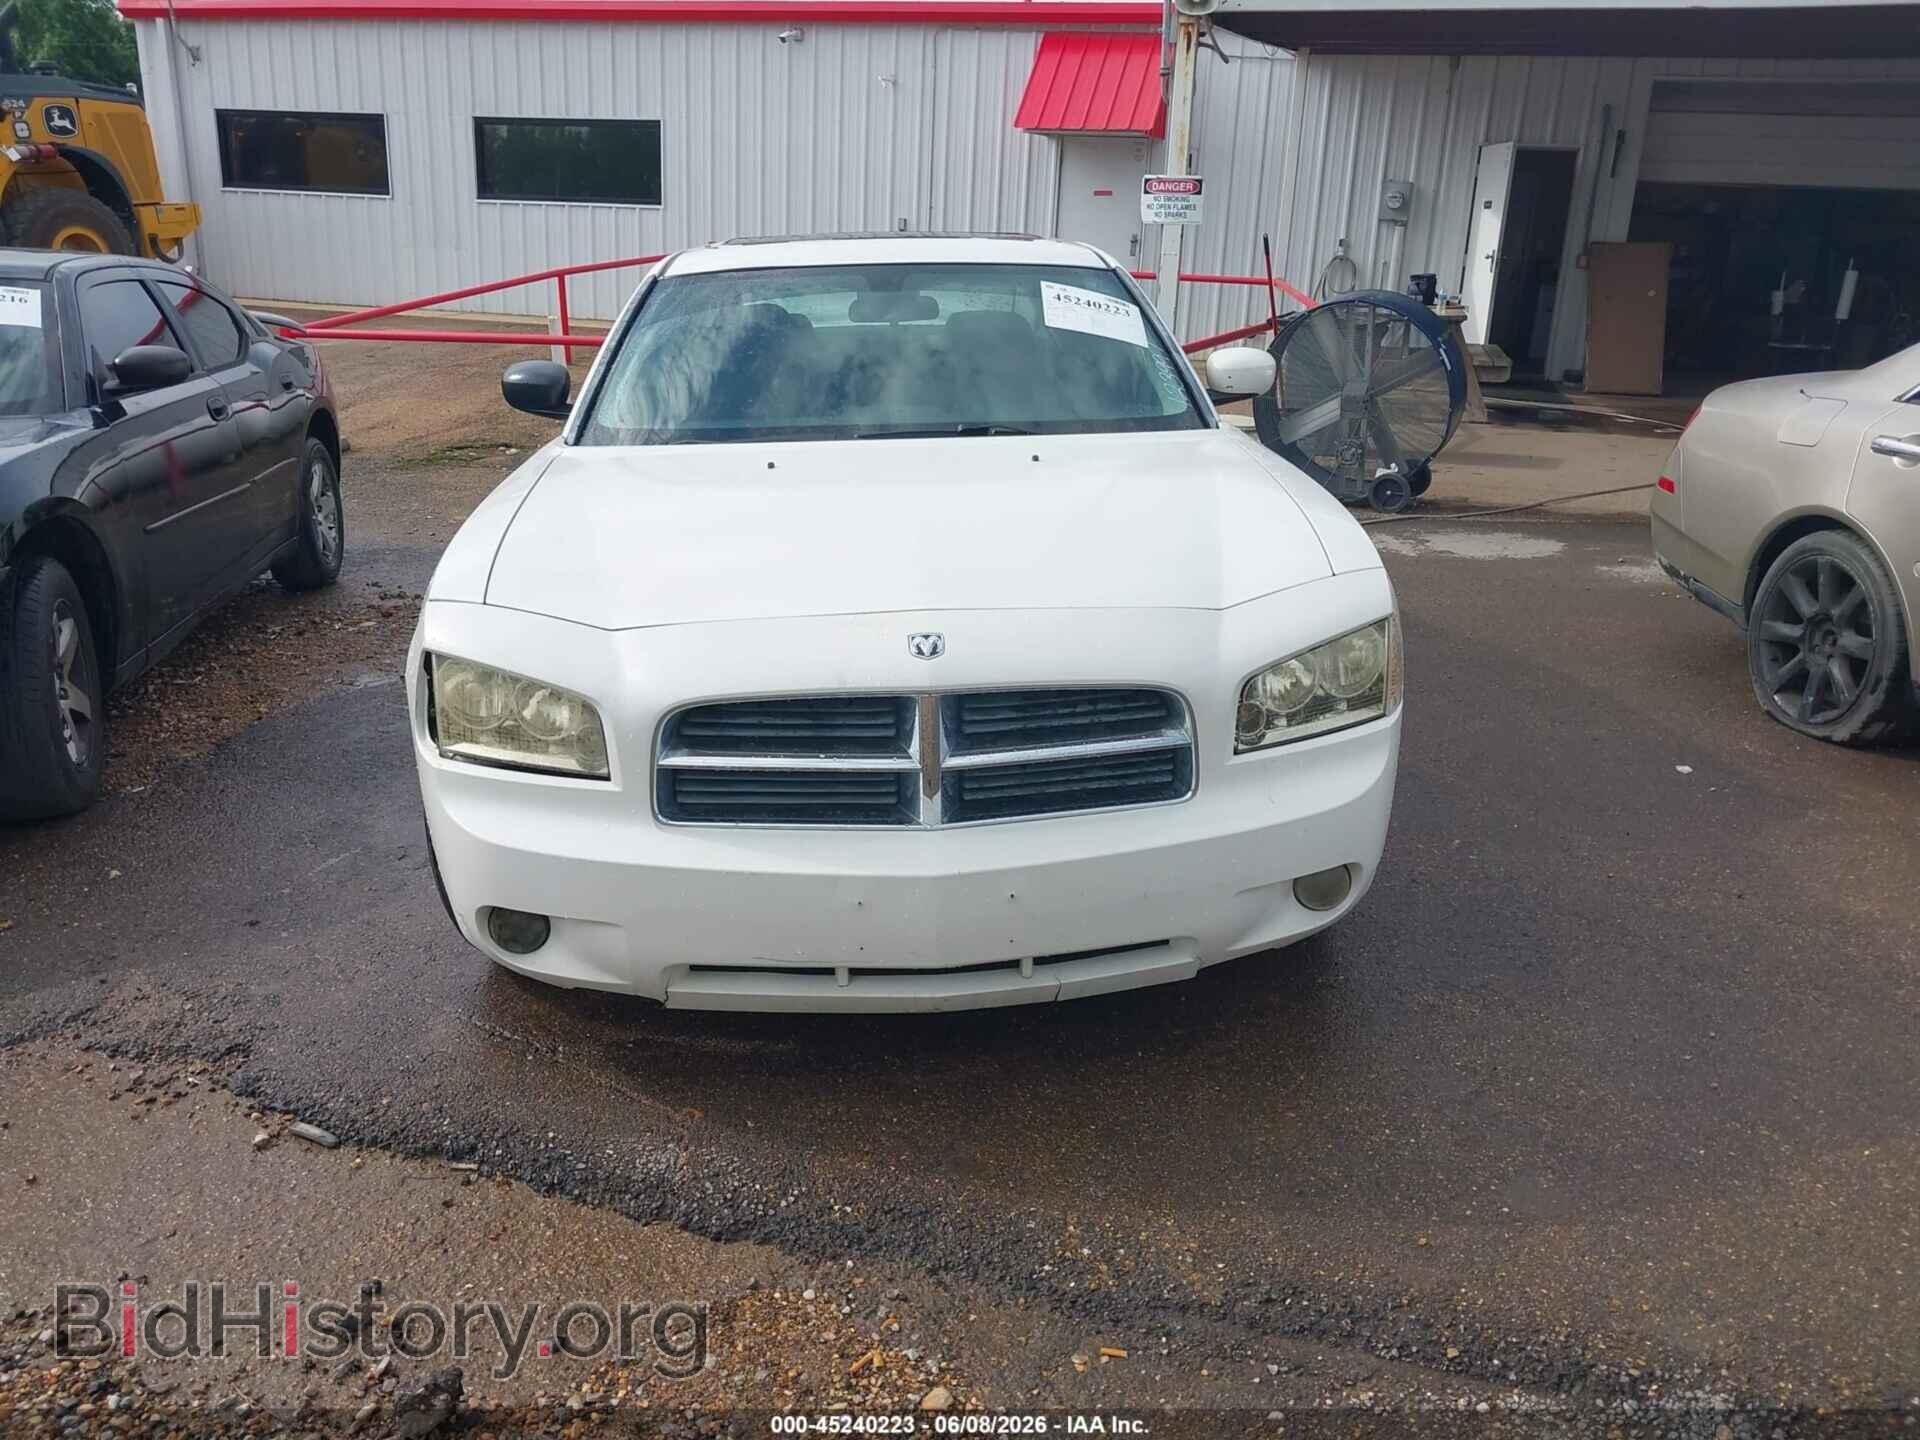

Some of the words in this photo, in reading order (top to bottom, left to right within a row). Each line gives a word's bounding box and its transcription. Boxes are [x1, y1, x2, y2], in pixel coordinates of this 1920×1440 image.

[1152, 182, 1194, 192] DANGER
[1155, 203, 1172, 211] OPEN
[1173, 203, 1197, 211] FLAMES
[1052, 293, 1131, 317] 45240223
